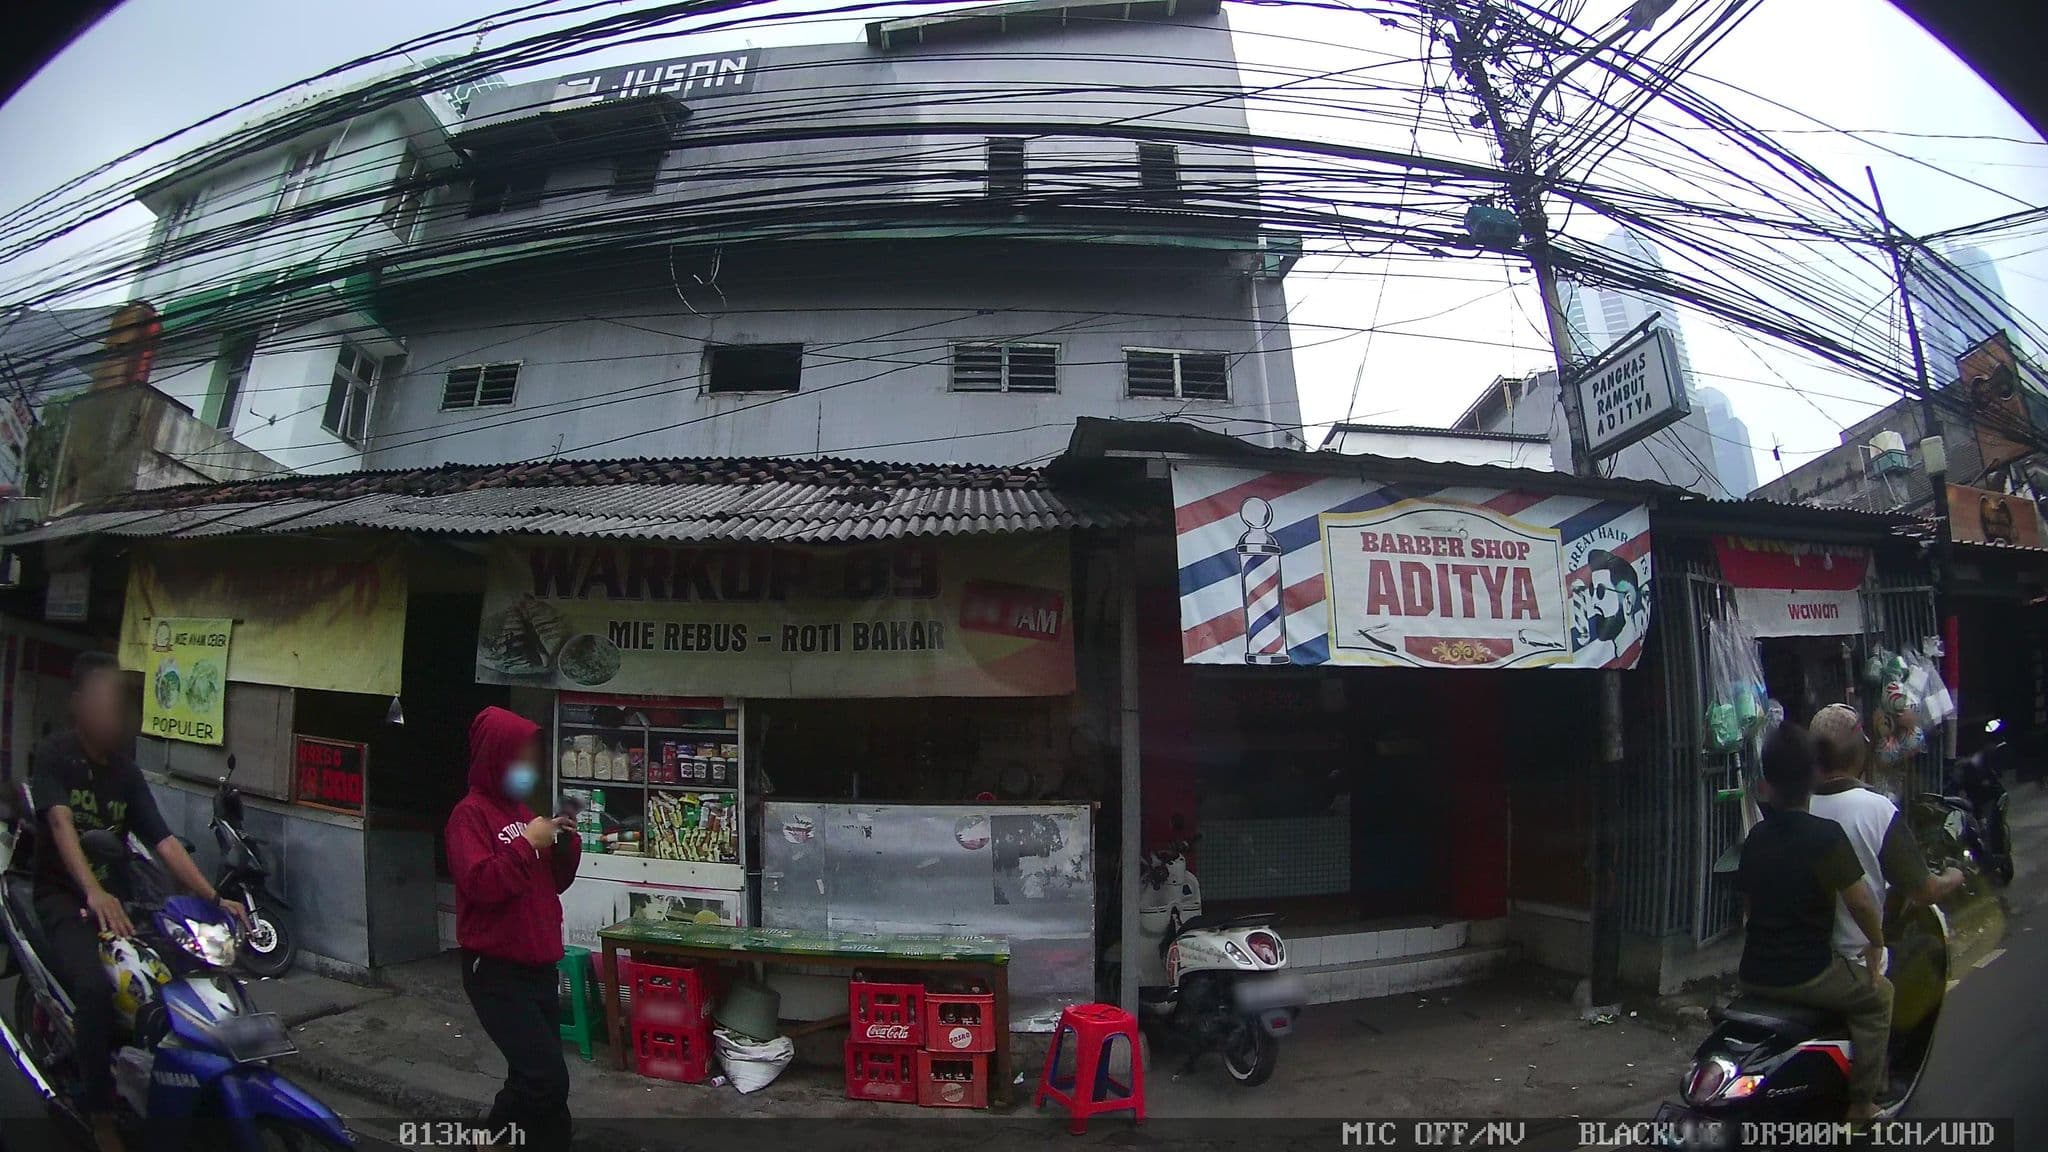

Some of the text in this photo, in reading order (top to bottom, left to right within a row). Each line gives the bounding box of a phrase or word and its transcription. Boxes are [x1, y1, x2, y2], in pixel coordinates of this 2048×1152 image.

[1592, 352, 1646, 399] PANGKAS
[1597, 375, 1645, 416] RAMBUT
[1597, 393, 1652, 437] ADITYA
[1360, 531, 1531, 561] BARBER SHOP
[1568, 529, 1597, 573] GREAT
[1366, 559, 1541, 620] ADITYA
[1788, 602, 1839, 620] wawan
[608, 620, 654, 650] MIE
[664, 623, 747, 652] REBUS
[781, 624, 841, 652] ROTI
[853, 620, 944, 651] BAKAR
[152, 716, 214, 739] POPULER
